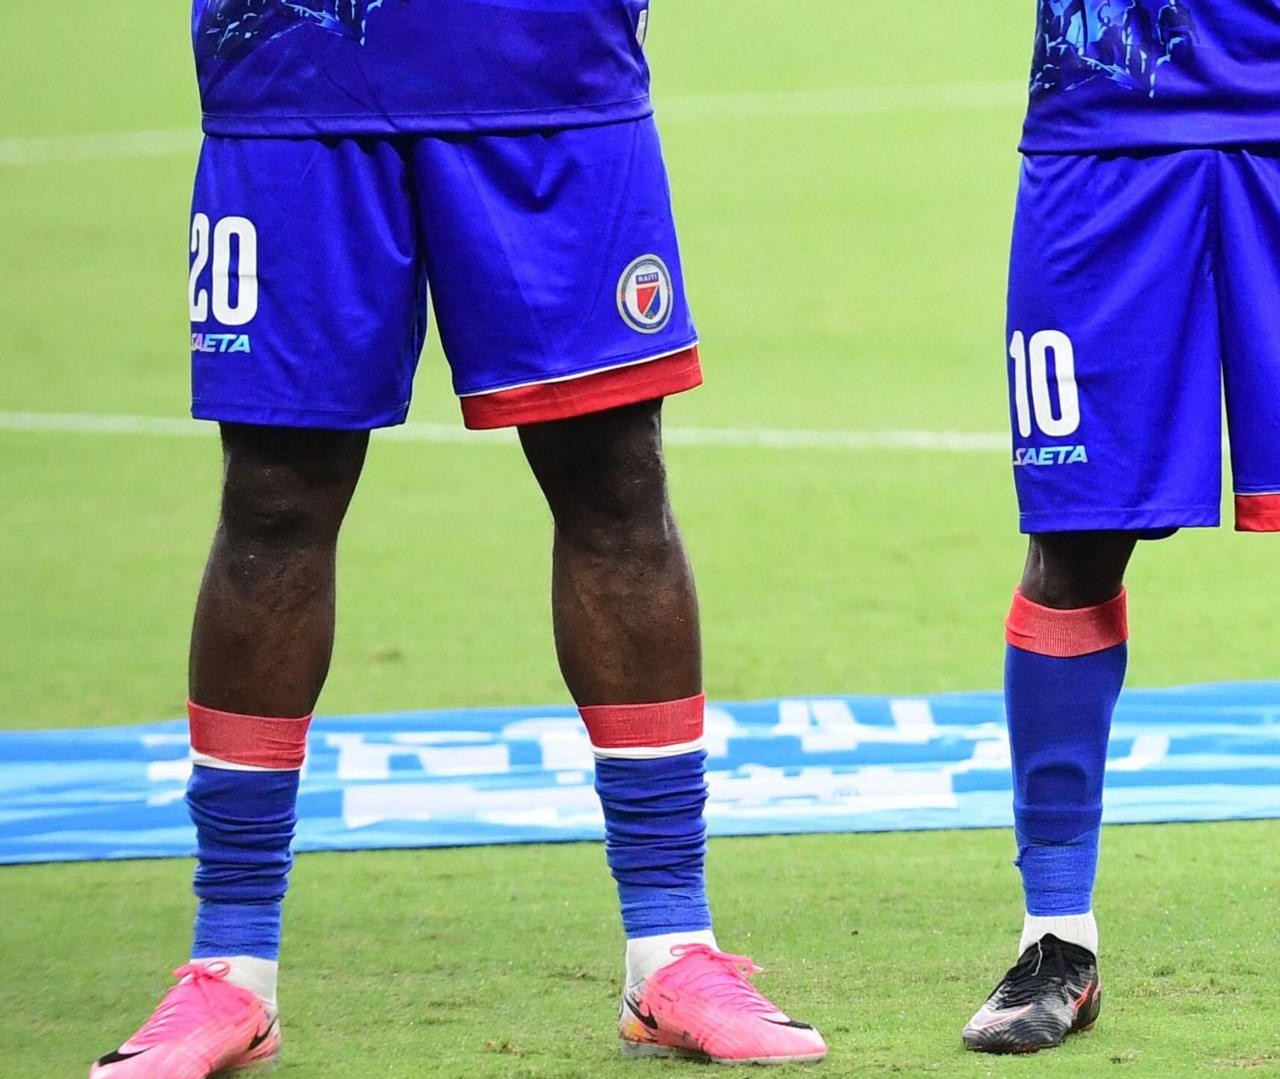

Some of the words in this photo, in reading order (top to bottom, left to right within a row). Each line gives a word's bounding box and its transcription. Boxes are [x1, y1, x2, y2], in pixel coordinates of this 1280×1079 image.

[188, 212, 259, 326] 20
[1009, 329, 1080, 438] 10
[1013, 445, 1088, 466] SAETA
